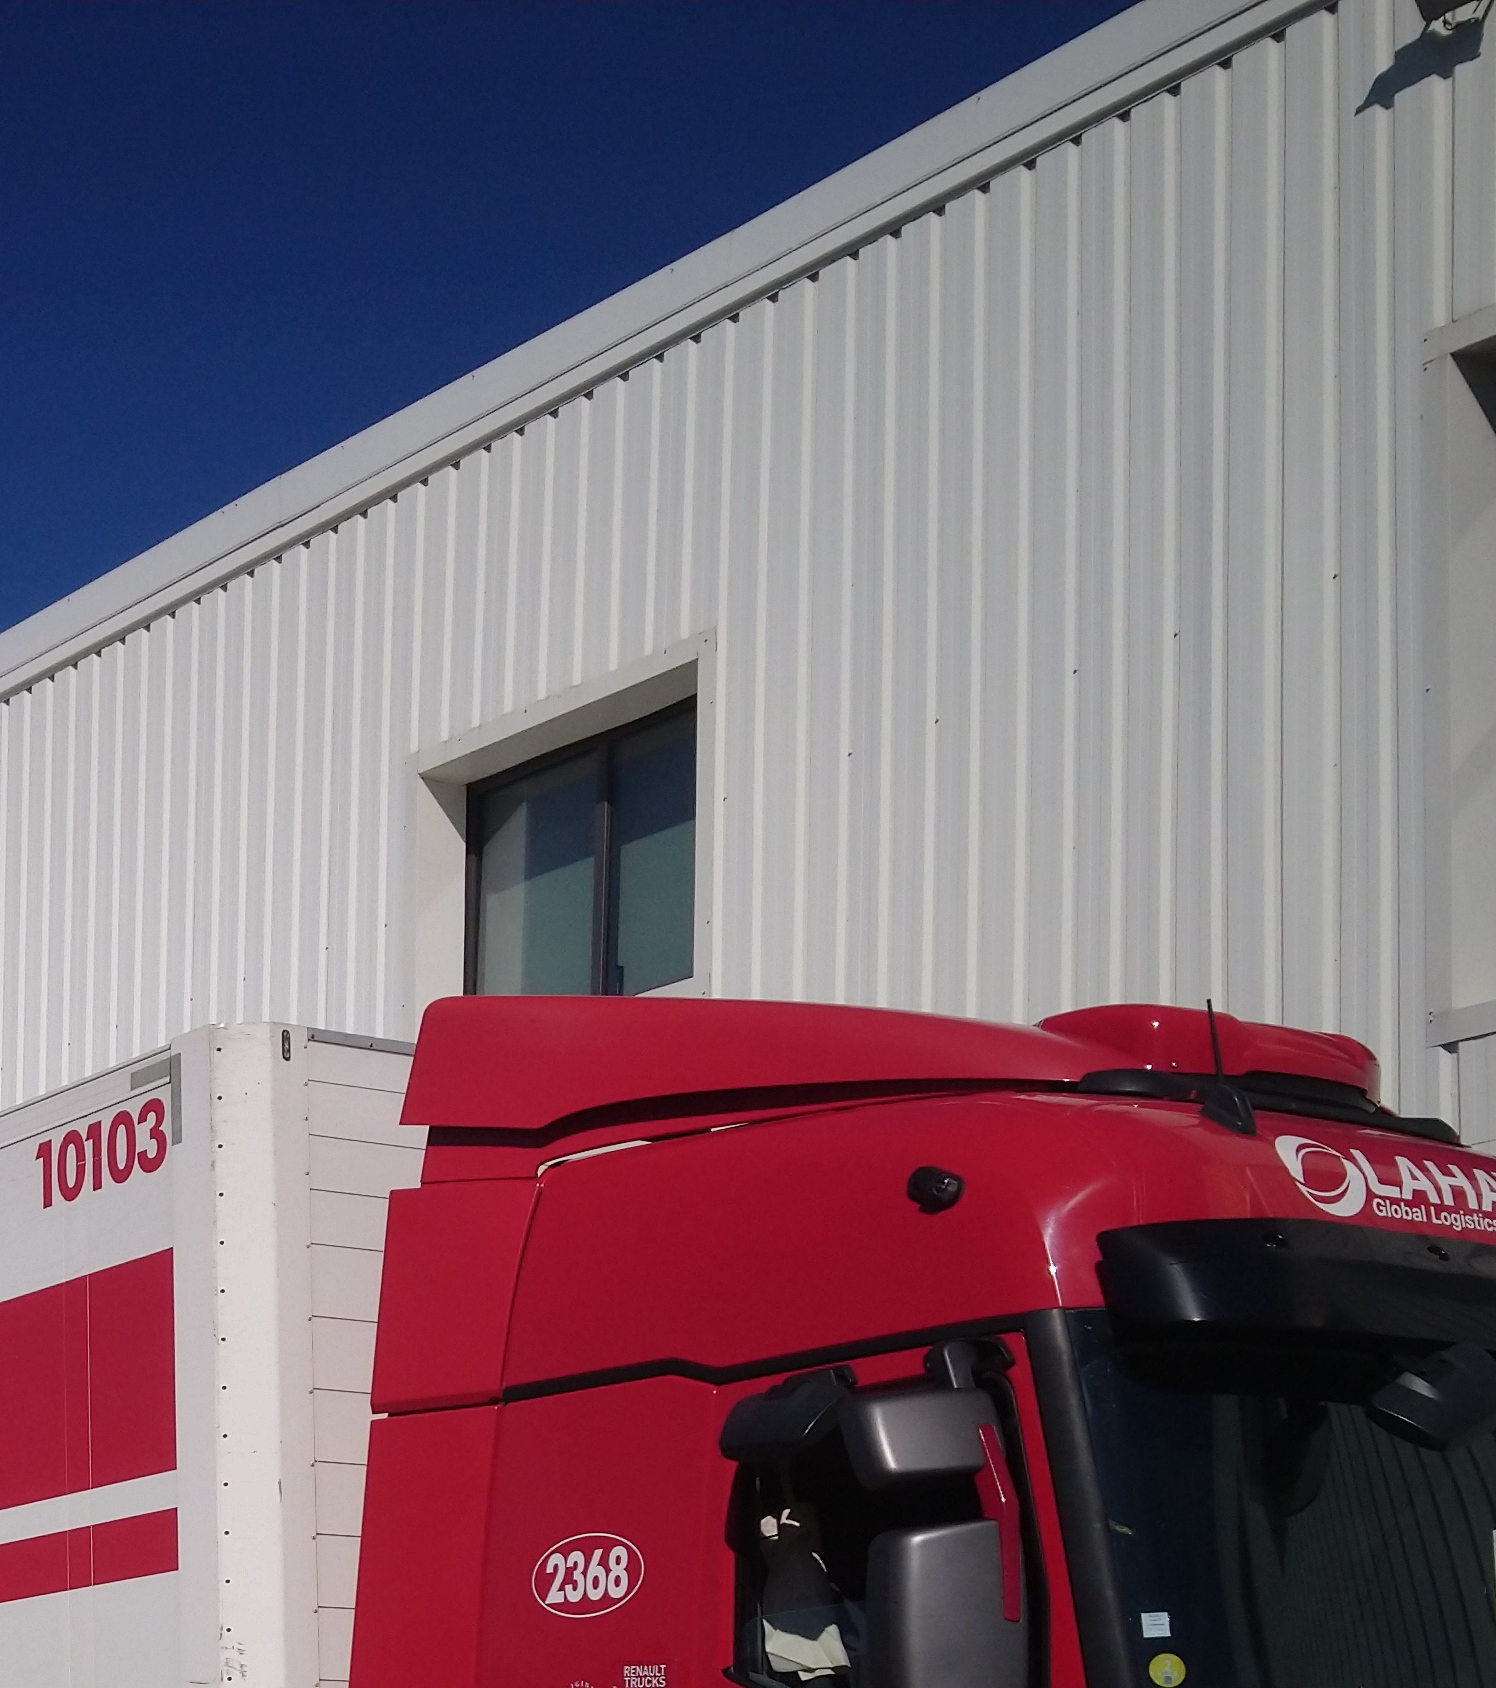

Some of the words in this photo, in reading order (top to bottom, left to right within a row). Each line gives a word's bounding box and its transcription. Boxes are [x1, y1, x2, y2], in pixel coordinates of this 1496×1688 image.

[35, 1098, 167, 1209] 10103
[1372, 1198, 1427, 1222] Global
[545, 1546, 629, 1604] 2368
[623, 1664, 667, 1677] RENAULT
[624, 1676, 667, 1688] TRUCKS
